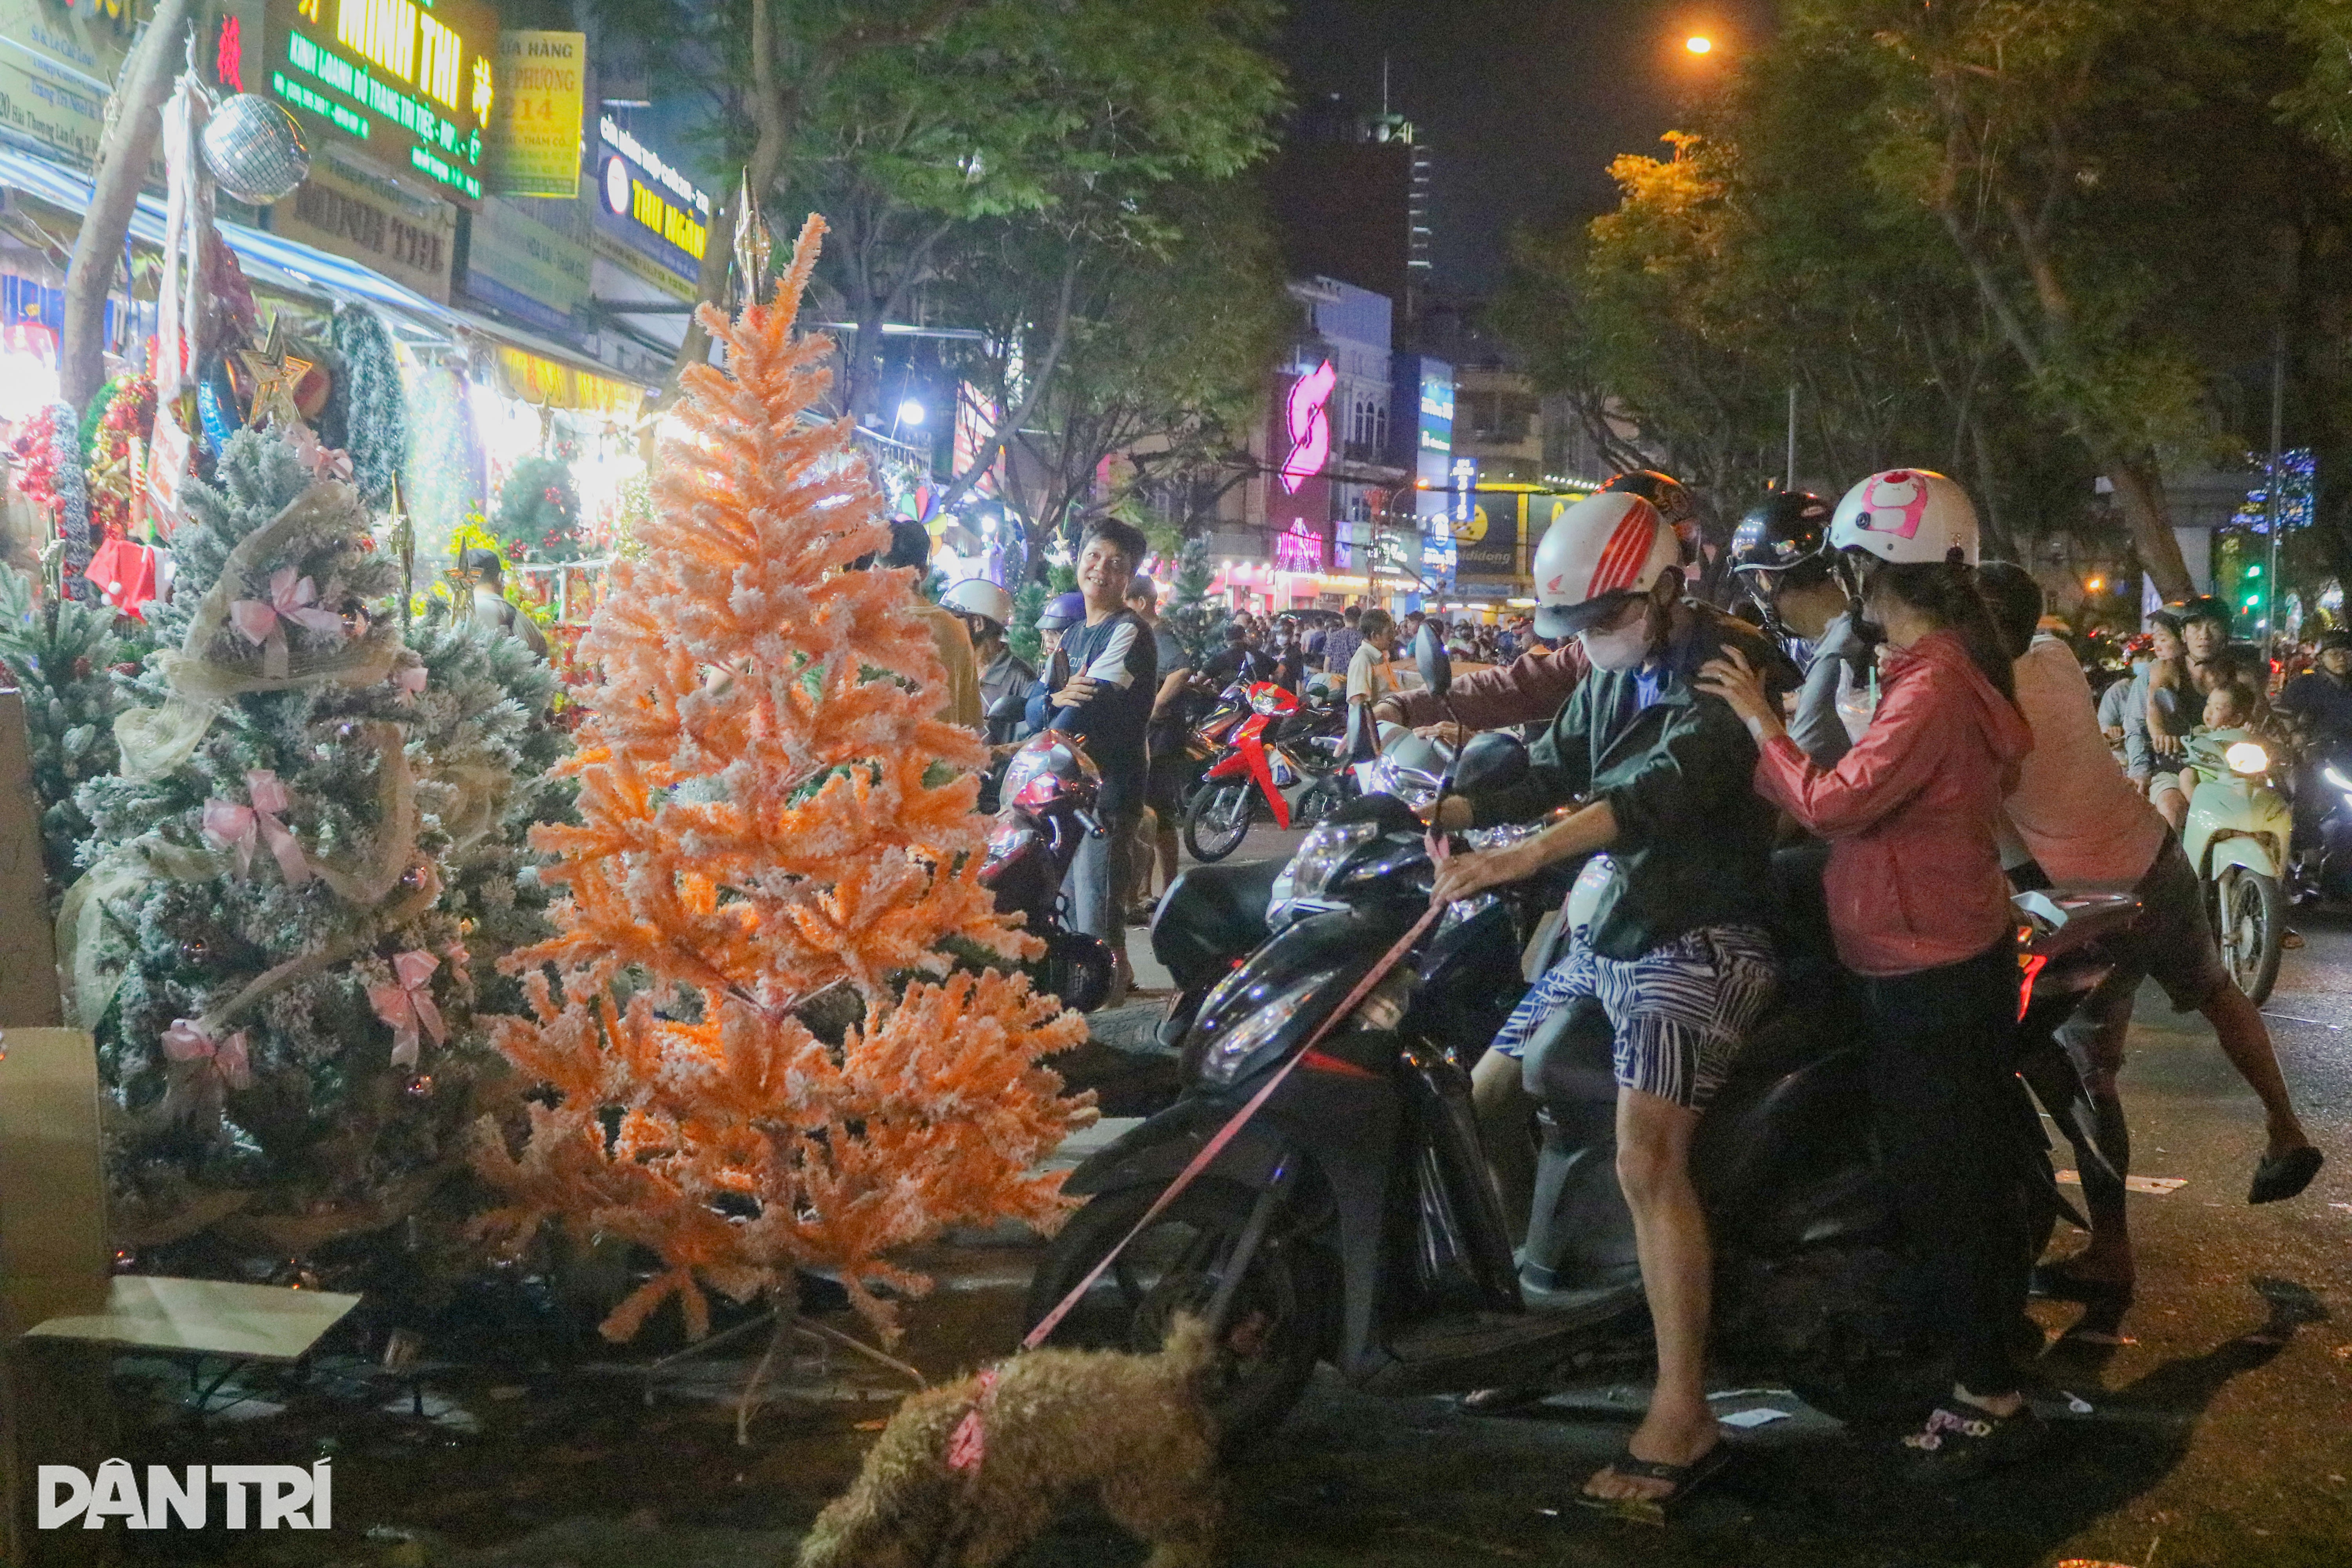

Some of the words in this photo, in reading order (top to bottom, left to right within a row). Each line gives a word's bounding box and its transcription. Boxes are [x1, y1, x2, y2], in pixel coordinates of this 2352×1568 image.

[289, 29, 318, 76] KINH
[338, 0, 416, 83] MINH
[420, 11, 462, 111] THI
[528, 38, 573, 58] HÀNG
[632, 178, 664, 234] THU
